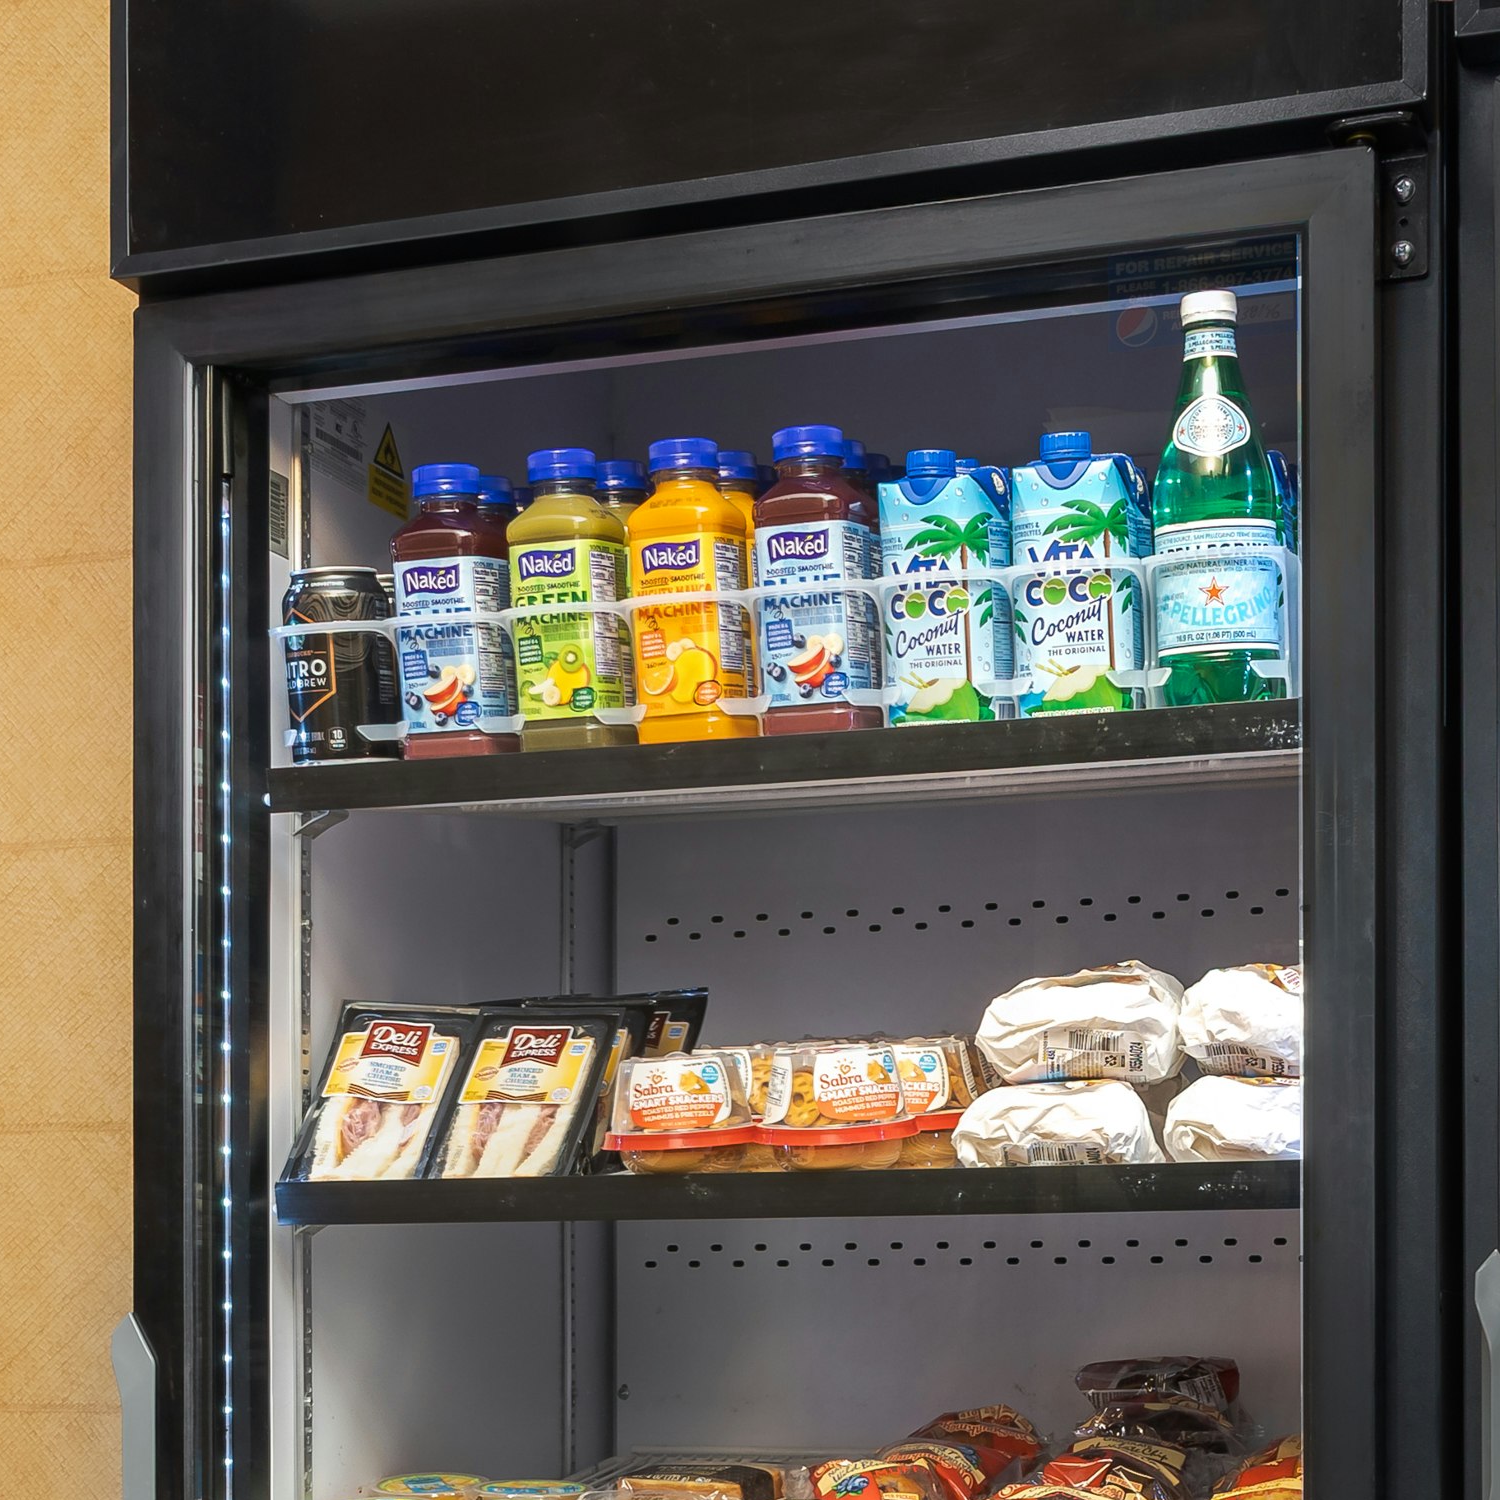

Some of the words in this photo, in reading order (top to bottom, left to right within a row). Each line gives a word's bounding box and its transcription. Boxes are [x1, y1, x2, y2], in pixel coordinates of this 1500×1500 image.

[890, 587, 971, 620] COCO
[400, 624, 474, 640] MACHINE
[895, 610, 963, 660] Coconut
[926, 643, 961, 656] WATER
[926, 658, 962, 668] ORIGINAL
[371, 1025, 422, 1049] Deli
[373, 1041, 419, 1058] EXPRESS
[633, 1082, 675, 1100] Sabra
[632, 1096, 665, 1109] SMART
[666, 1092, 725, 1106] SNACKERS
